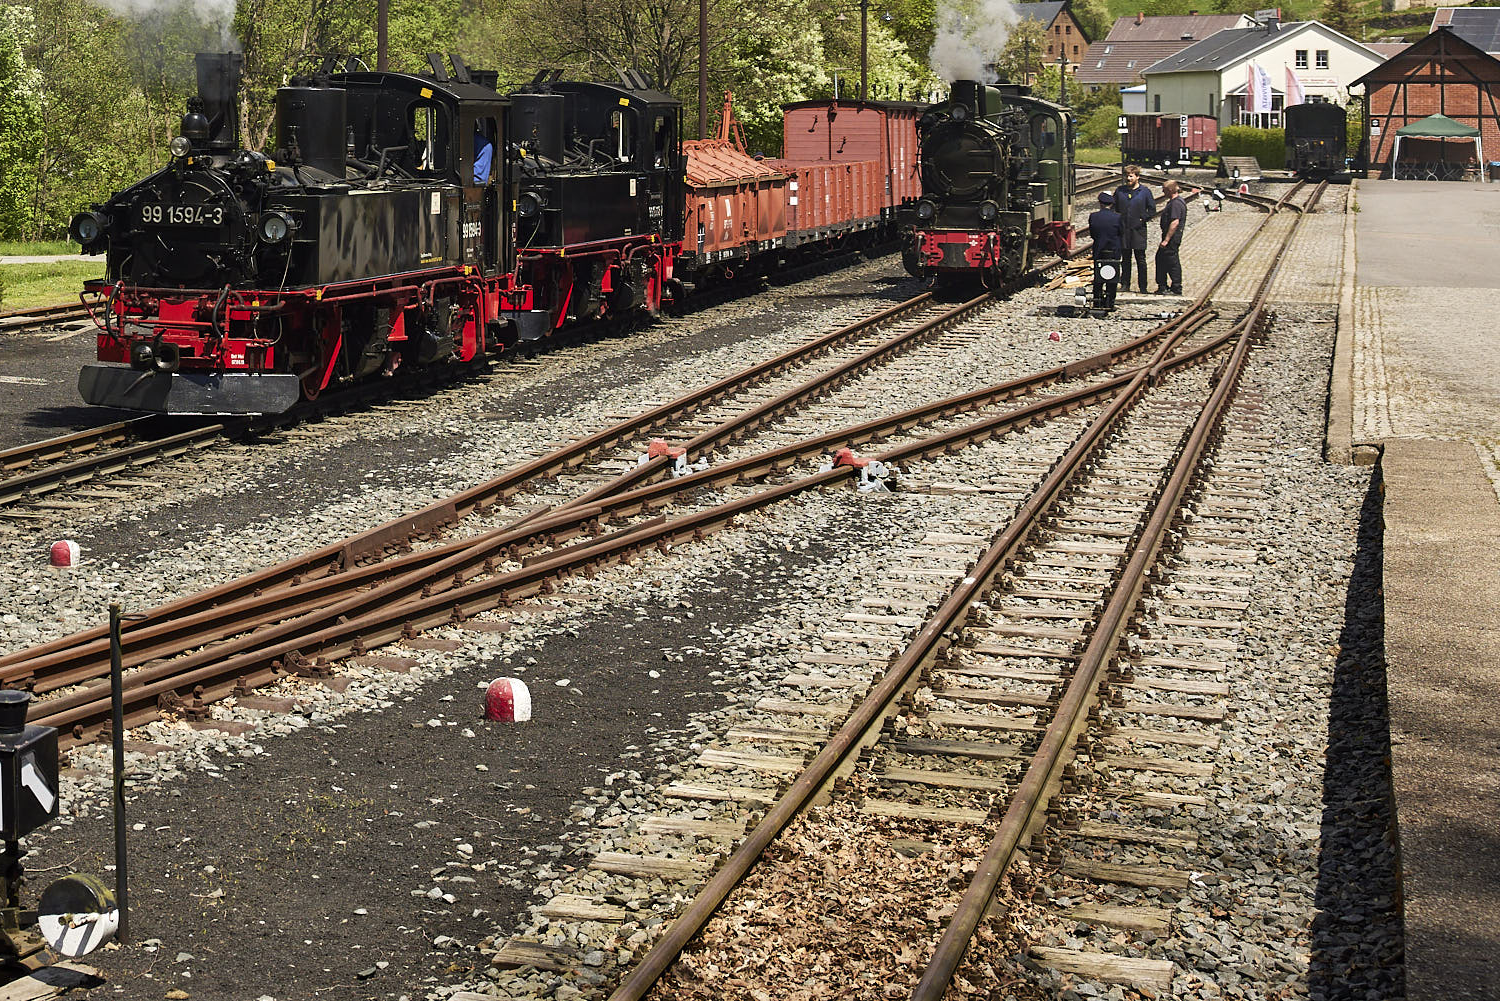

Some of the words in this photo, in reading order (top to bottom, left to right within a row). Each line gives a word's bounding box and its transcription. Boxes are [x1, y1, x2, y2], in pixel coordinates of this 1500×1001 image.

[1118, 116, 1127, 128] H
[1180, 148, 1189, 160] H
[142, 205, 162, 223] 99
[167, 206, 223, 225] 1594-3
